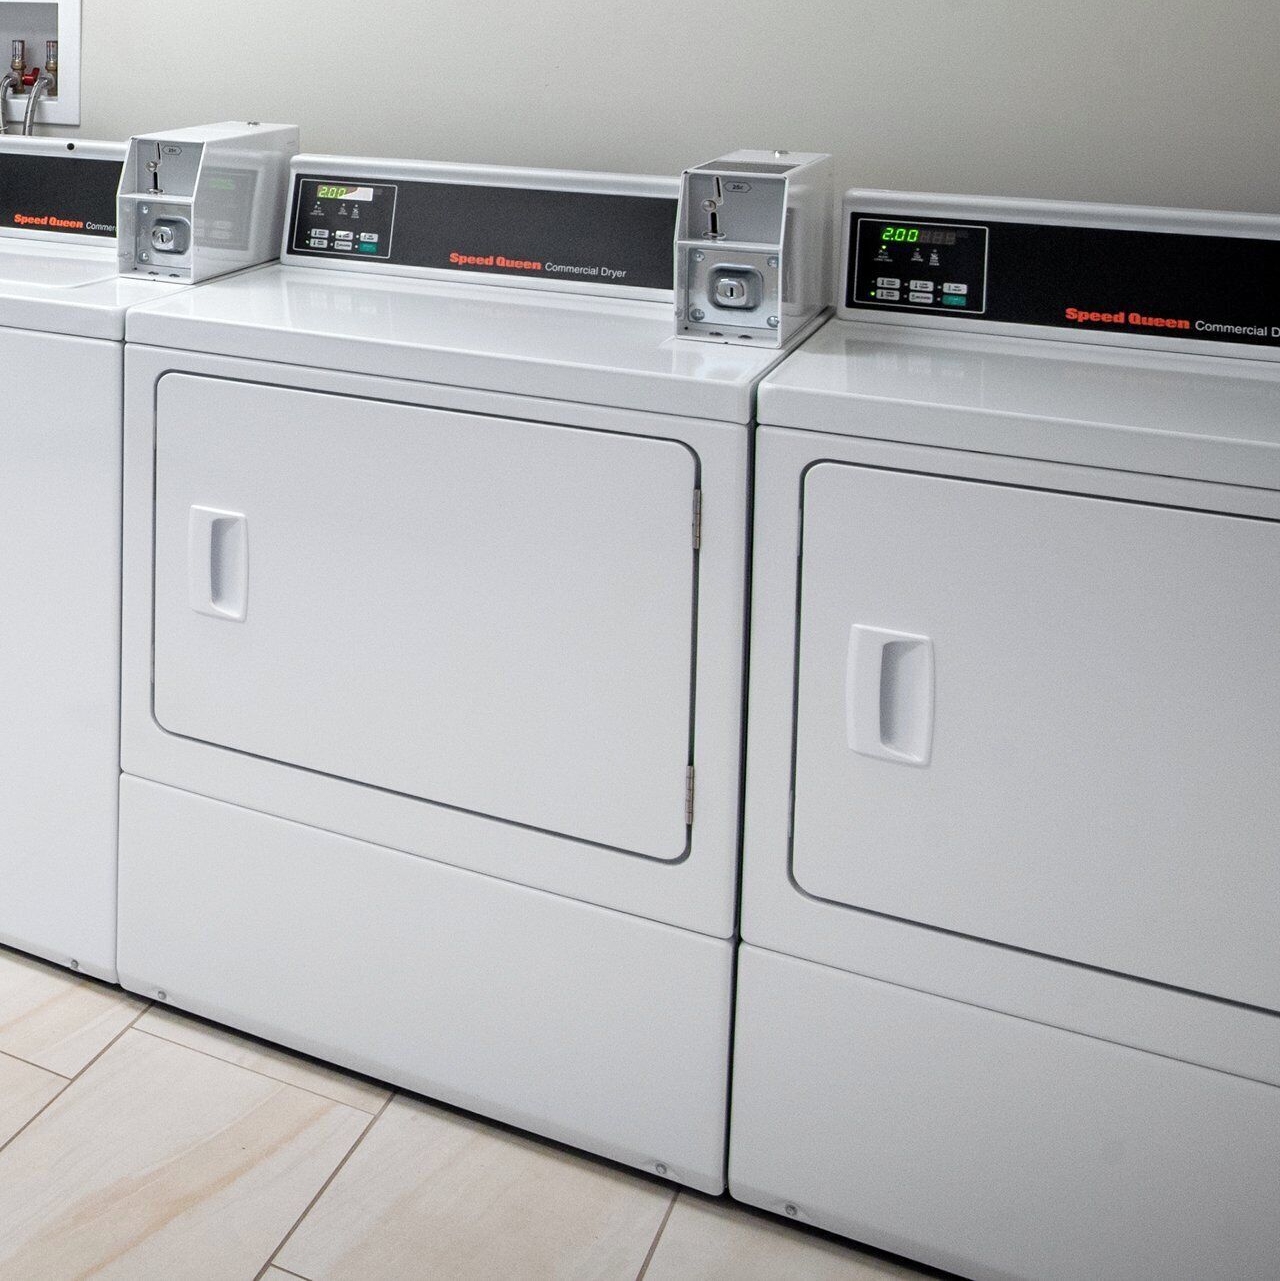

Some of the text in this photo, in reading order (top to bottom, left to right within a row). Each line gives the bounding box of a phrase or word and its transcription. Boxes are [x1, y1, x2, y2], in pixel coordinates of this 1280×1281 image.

[319, 186, 346, 198] 2.00
[14, 213, 47, 226] Speed
[49, 216, 84, 229] Queen
[882, 227, 919, 242] 2.00
[449, 252, 627, 280] Speed Queen Commercial Dryer
[1065, 307, 1125, 323] Speed
[1128, 312, 1190, 329] Queen
[1195, 320, 1268, 337] Commercial
